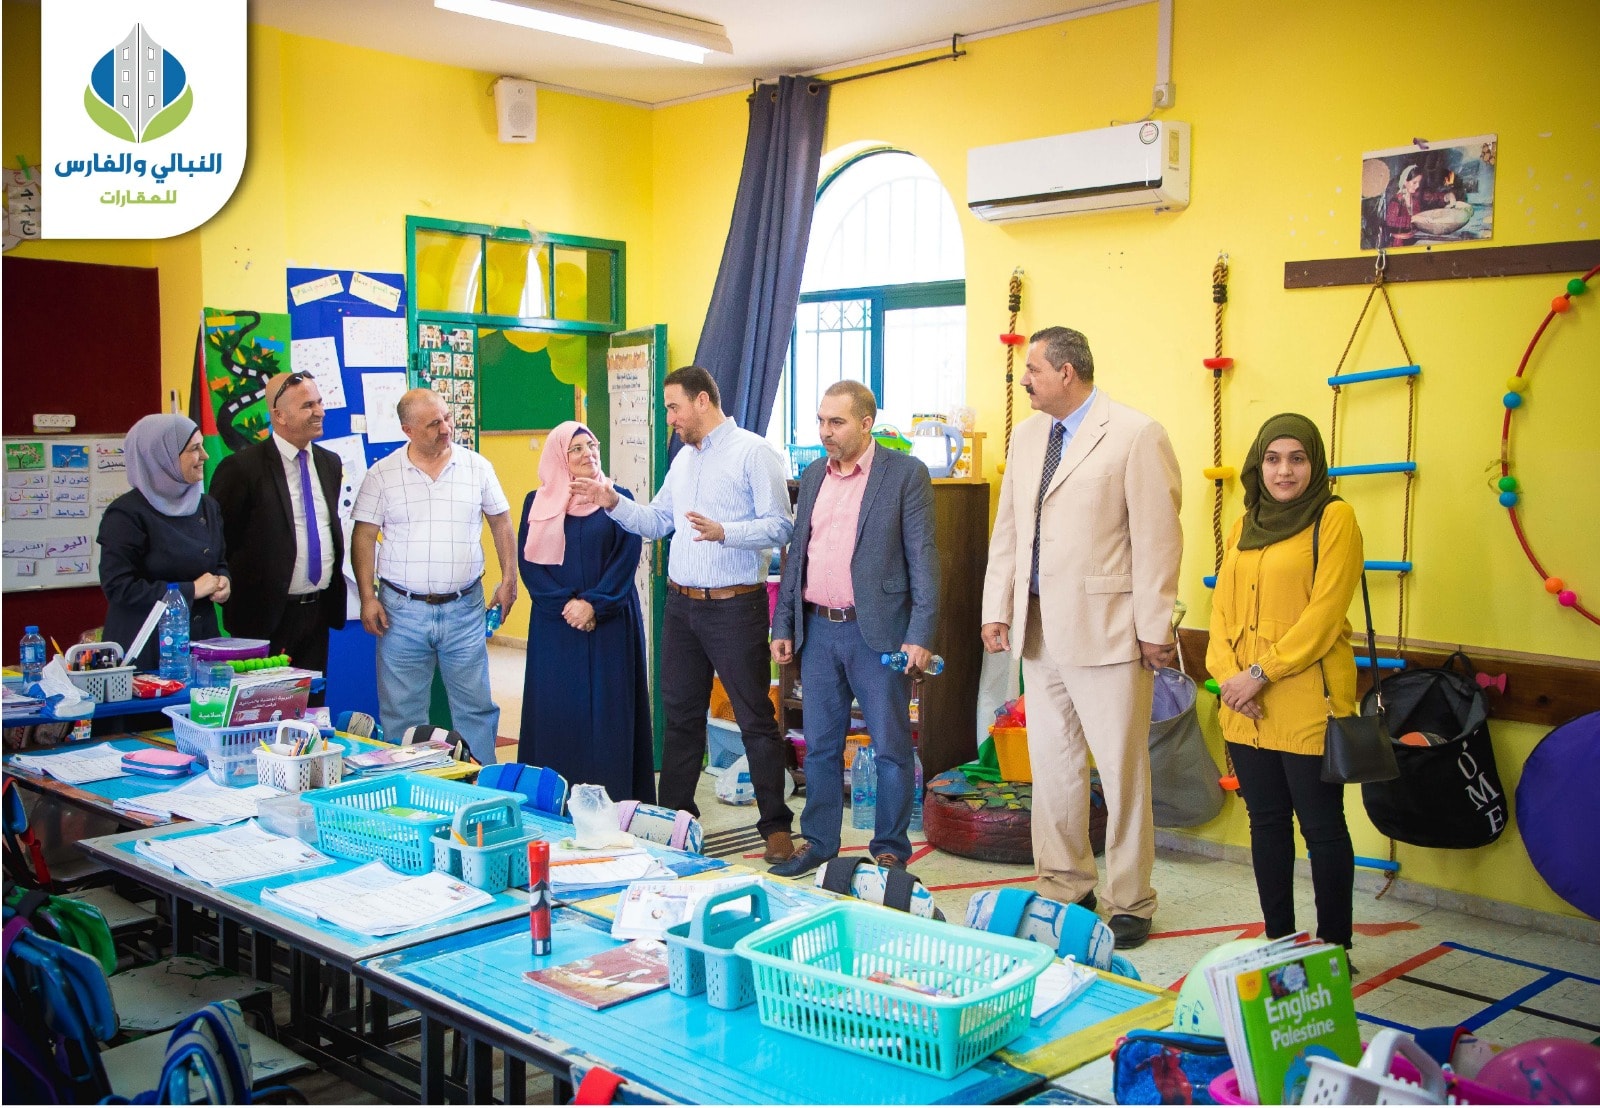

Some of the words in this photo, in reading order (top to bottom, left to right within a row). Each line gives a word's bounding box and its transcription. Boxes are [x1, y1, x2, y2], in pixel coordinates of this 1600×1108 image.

[9, 489, 49, 502] نيسان
[55, 508, 86, 518] شباط
[2, 543, 44, 556] التاري
[46, 535, 87, 556] اليوم
[1264, 983, 1332, 1024] English
[1270, 1018, 1335, 1051] Palestine
